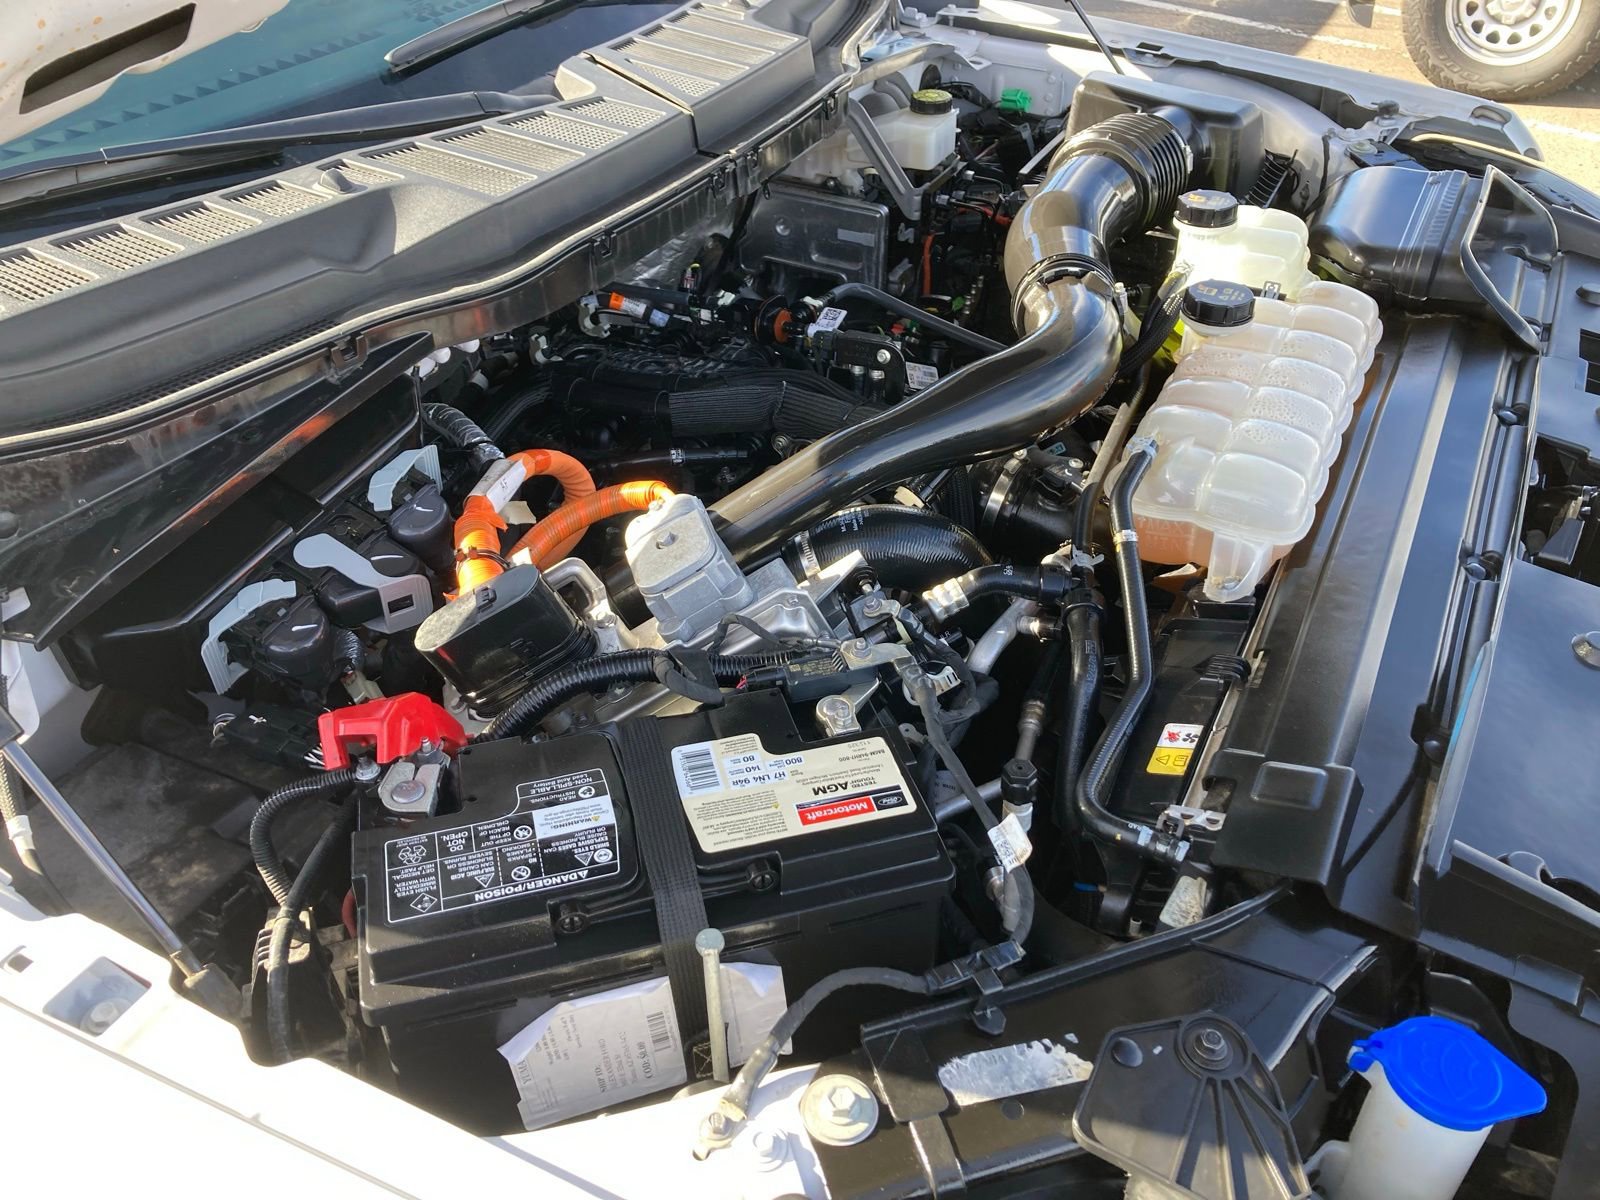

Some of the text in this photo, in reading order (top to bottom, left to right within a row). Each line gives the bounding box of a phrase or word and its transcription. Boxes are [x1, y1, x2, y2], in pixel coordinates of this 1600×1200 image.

[742, 754, 754, 762] 80
[785, 756, 802, 765] 800
[744, 764, 760, 772] 140
[731, 777, 750, 785] 94R
[752, 773, 770, 782] LN4
[529, 776, 592, 794] NON-SPILLABLE
[532, 779, 555, 788] Battery
[811, 780, 849, 795] AGM
[851, 780, 877, 788] TESTED
[529, 790, 575, 803] INSTRUCTIONS.
[805, 801, 868, 821] Motorcraft
[476, 819, 509, 830] CHILDREN.
[549, 816, 592, 829] WARNING:
[488, 825, 510, 834] REACH
[440, 830, 468, 841] OPEN.
[494, 836, 511, 844] KEEP
[550, 830, 606, 846] CAUSE BLINDNESS
[577, 835, 608, 846] EXPLOSIVE
[446, 837, 465, 846] NOT
[557, 842, 576, 850] GASES
[589, 841, 609, 849] SHIELD
[449, 844, 463, 852] DO
[501, 842, 530, 852] SMOKING
[505, 847, 531, 856] FLAMES
[442, 850, 492, 865] SEVERE BURNS.
[457, 855, 493, 867] BLINDNESS
[506, 852, 532, 862] SPARKS
[399, 862, 434, 874] HELP FAST.
[450, 865, 494, 880] SULFURIC ACID
[457, 864, 479, 872] CAUSE
[391, 870, 420, 880] MEDICAL
[393, 879, 436, 892] IMMEDIATELY
[394, 878, 418, 888] WATER.
[473, 871, 579, 901] DANGER/POISON
[396, 884, 436, 897] FLUSH EYES
[641, 1058, 654, 1078] COD:
